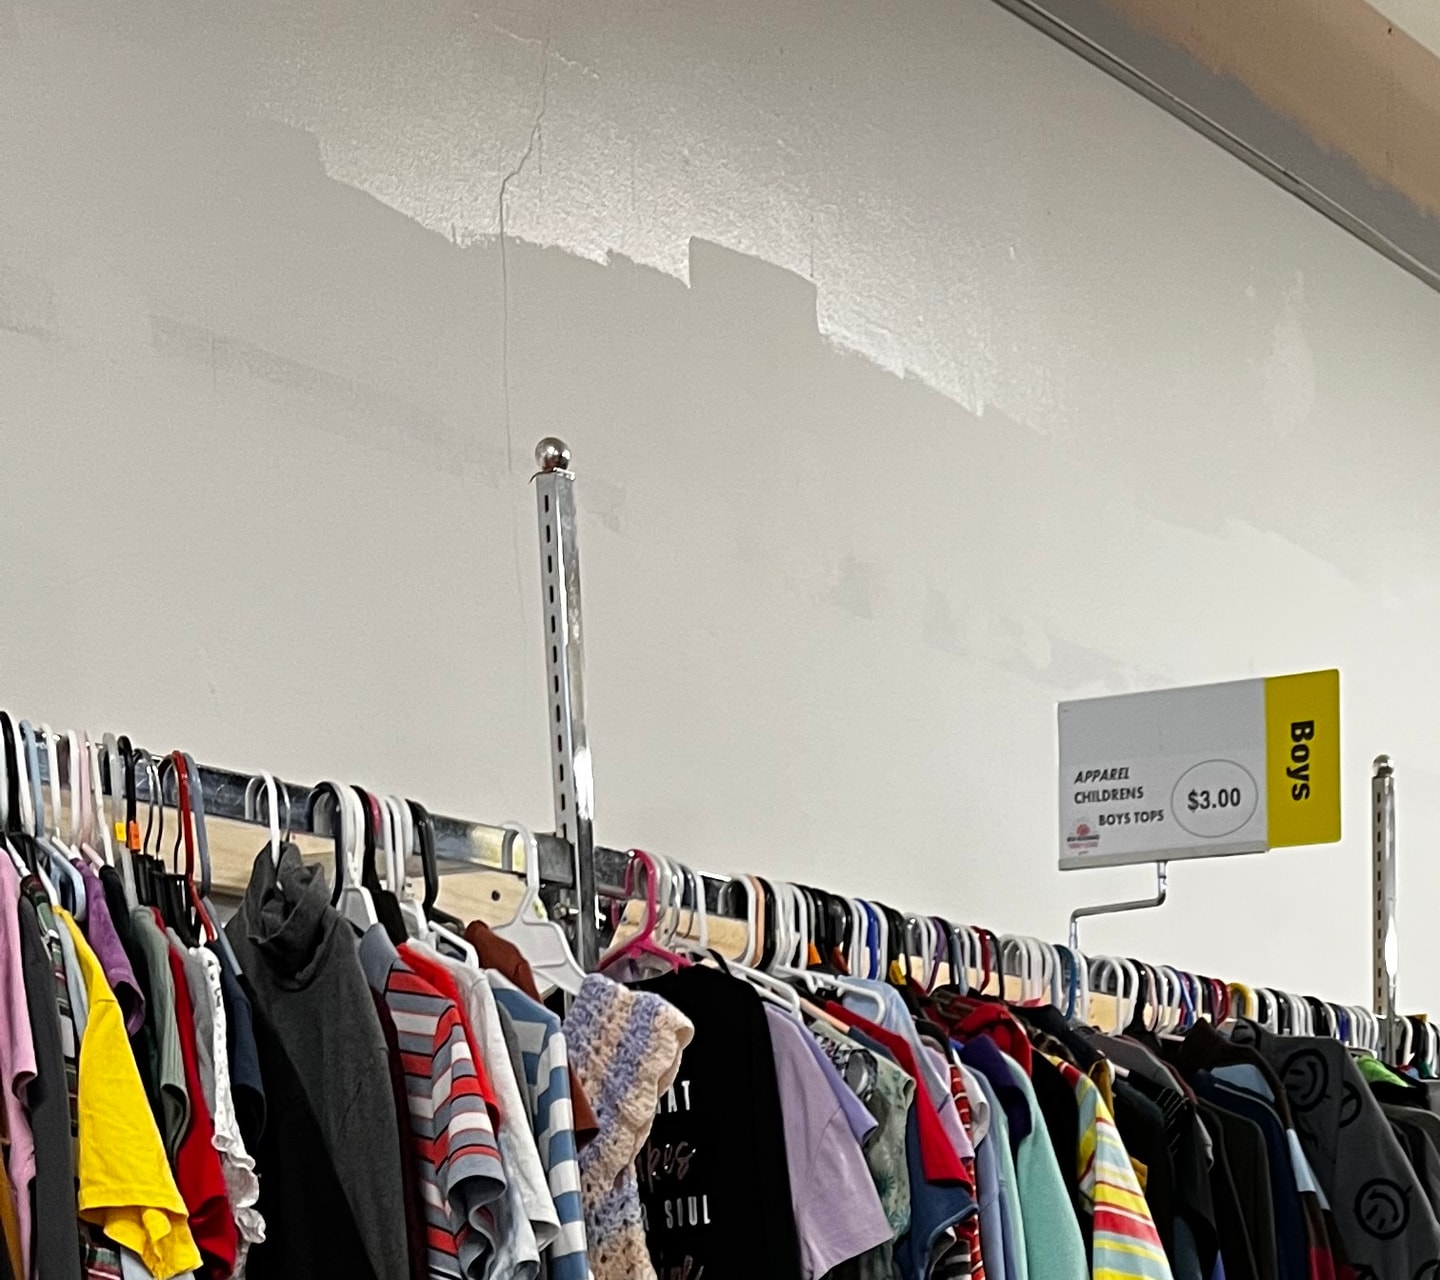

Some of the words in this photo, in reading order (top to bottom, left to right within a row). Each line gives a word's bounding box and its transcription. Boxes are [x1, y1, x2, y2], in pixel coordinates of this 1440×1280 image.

[1286, 719, 1315, 802] Boys
[1073, 766, 1131, 784] APPAREL
[1073, 786, 1144, 805] CHILDRENS
[1187, 787, 1241, 814] $3.00
[1098, 811, 1132, 827] BOYS
[1134, 808, 1165, 823] TOPS
